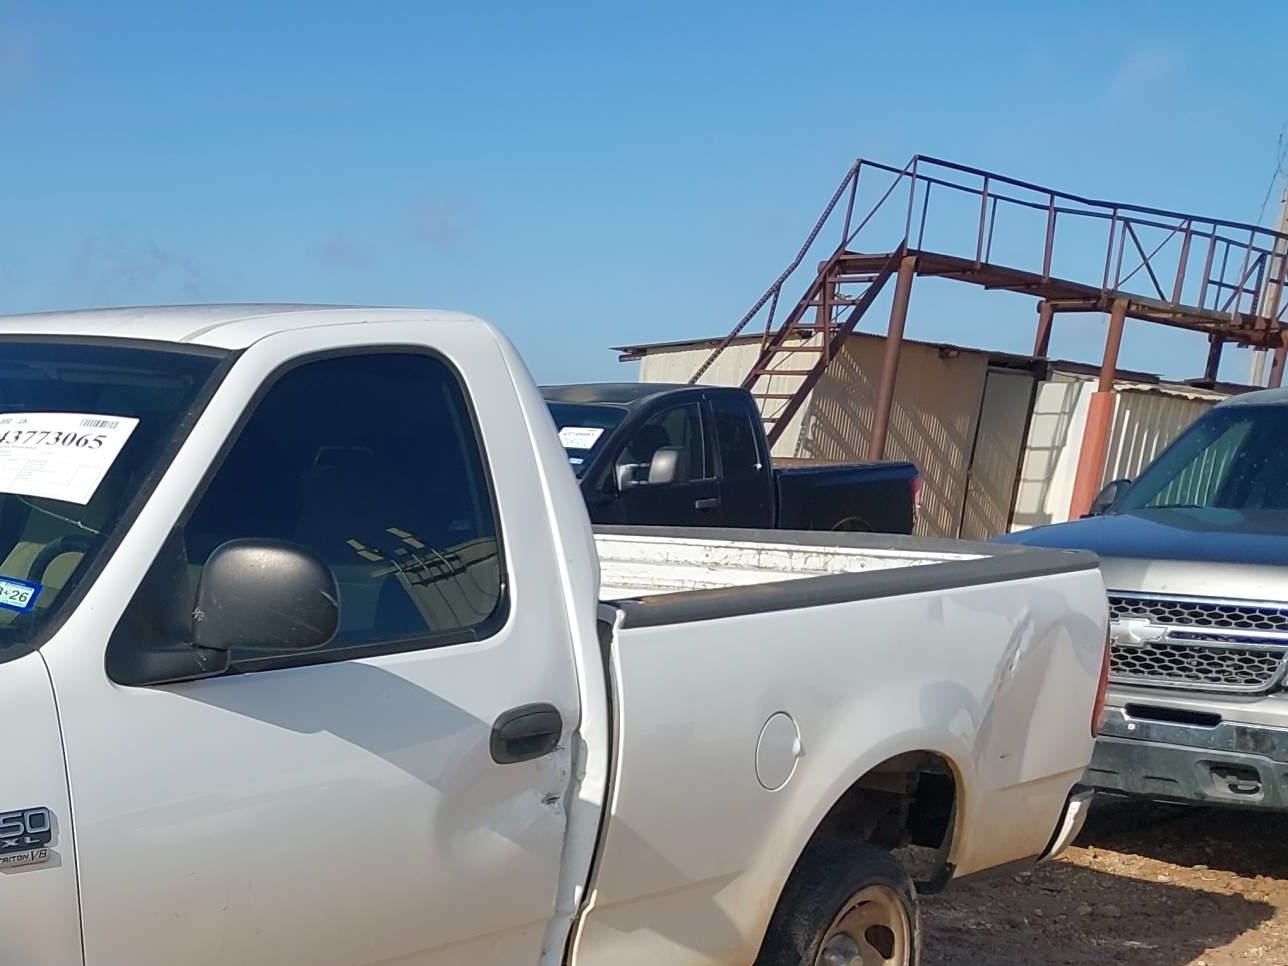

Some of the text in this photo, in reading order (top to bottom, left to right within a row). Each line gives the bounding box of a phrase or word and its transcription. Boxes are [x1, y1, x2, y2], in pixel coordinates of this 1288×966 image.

[9, 590, 29, 602] 26
[1, 836, 41, 849] XL
[30, 848, 48, 862] V8
